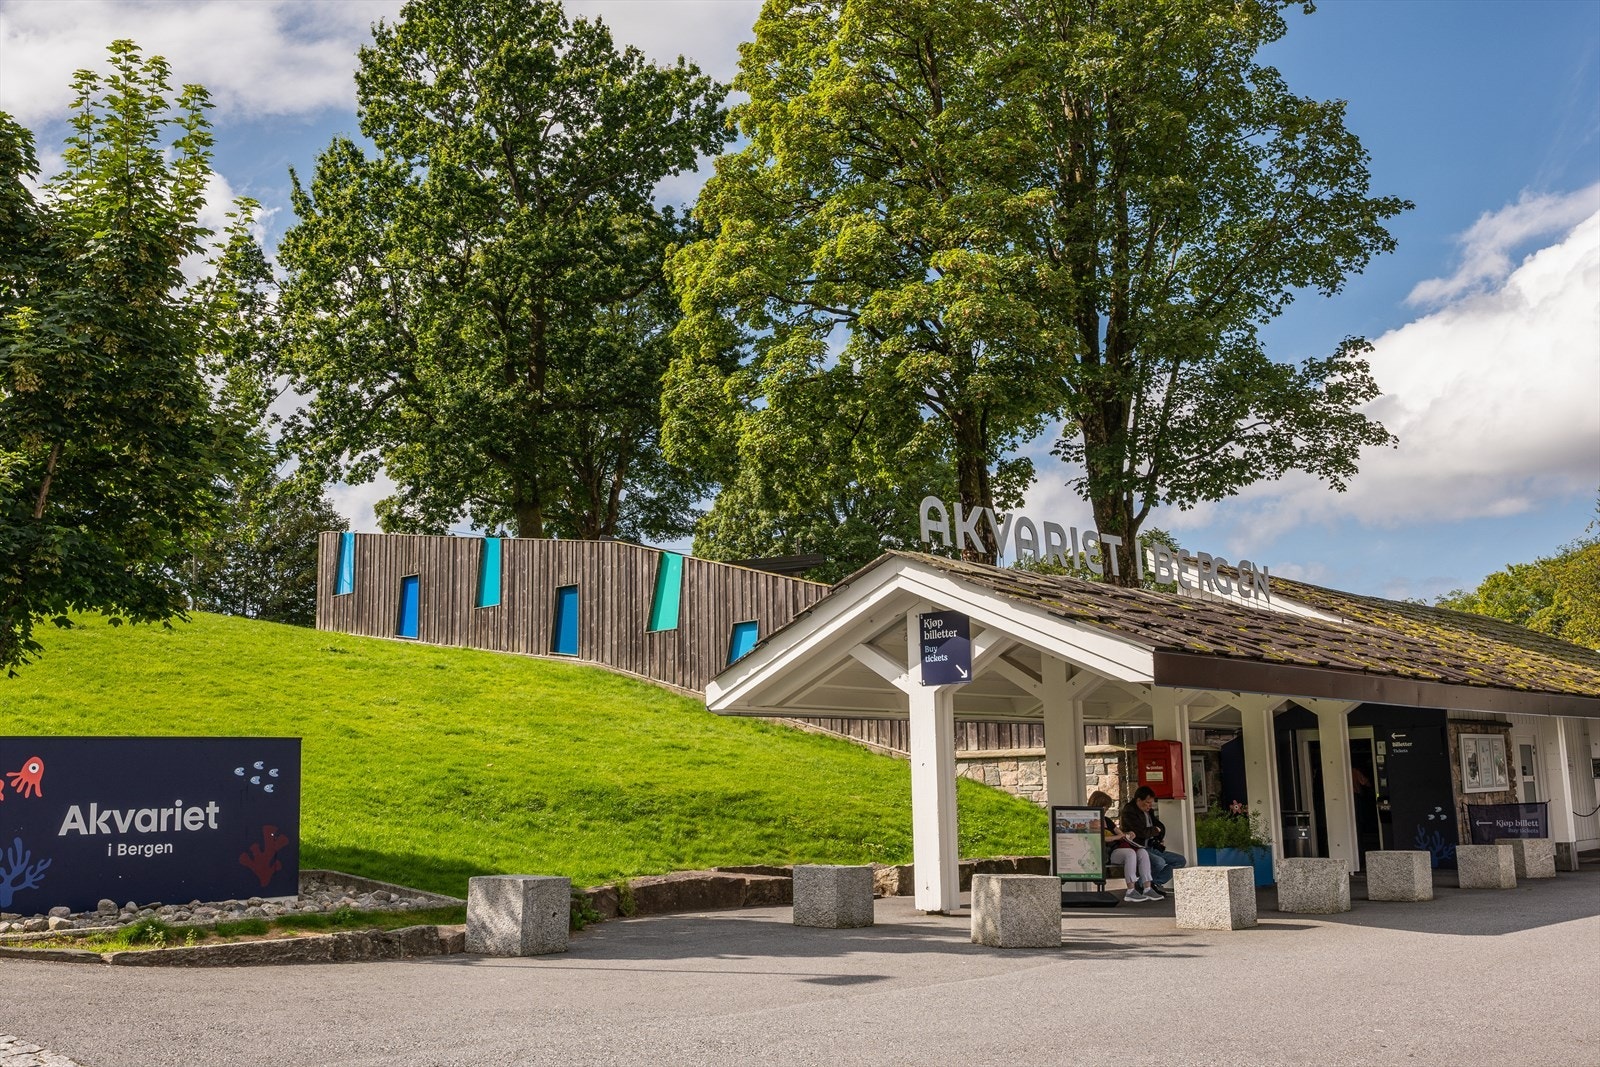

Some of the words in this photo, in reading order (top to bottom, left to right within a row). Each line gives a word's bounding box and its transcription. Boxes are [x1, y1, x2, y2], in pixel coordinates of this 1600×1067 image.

[919, 495, 1122, 577] AKVARIET
[1135, 539, 1144, 580] I
[1152, 541, 1270, 603] BERGEN
[923, 618, 944, 630] Kjøp
[924, 629, 958, 640] billetter
[924, 645, 938, 654] Buy
[925, 654, 948, 663] tickets
[58, 799, 220, 836] Akvariet
[1496, 819, 1514, 828] Kjøp
[1515, 819, 1539, 827] billett
[107, 843, 112, 857] i
[117, 843, 173, 858] Bergen
